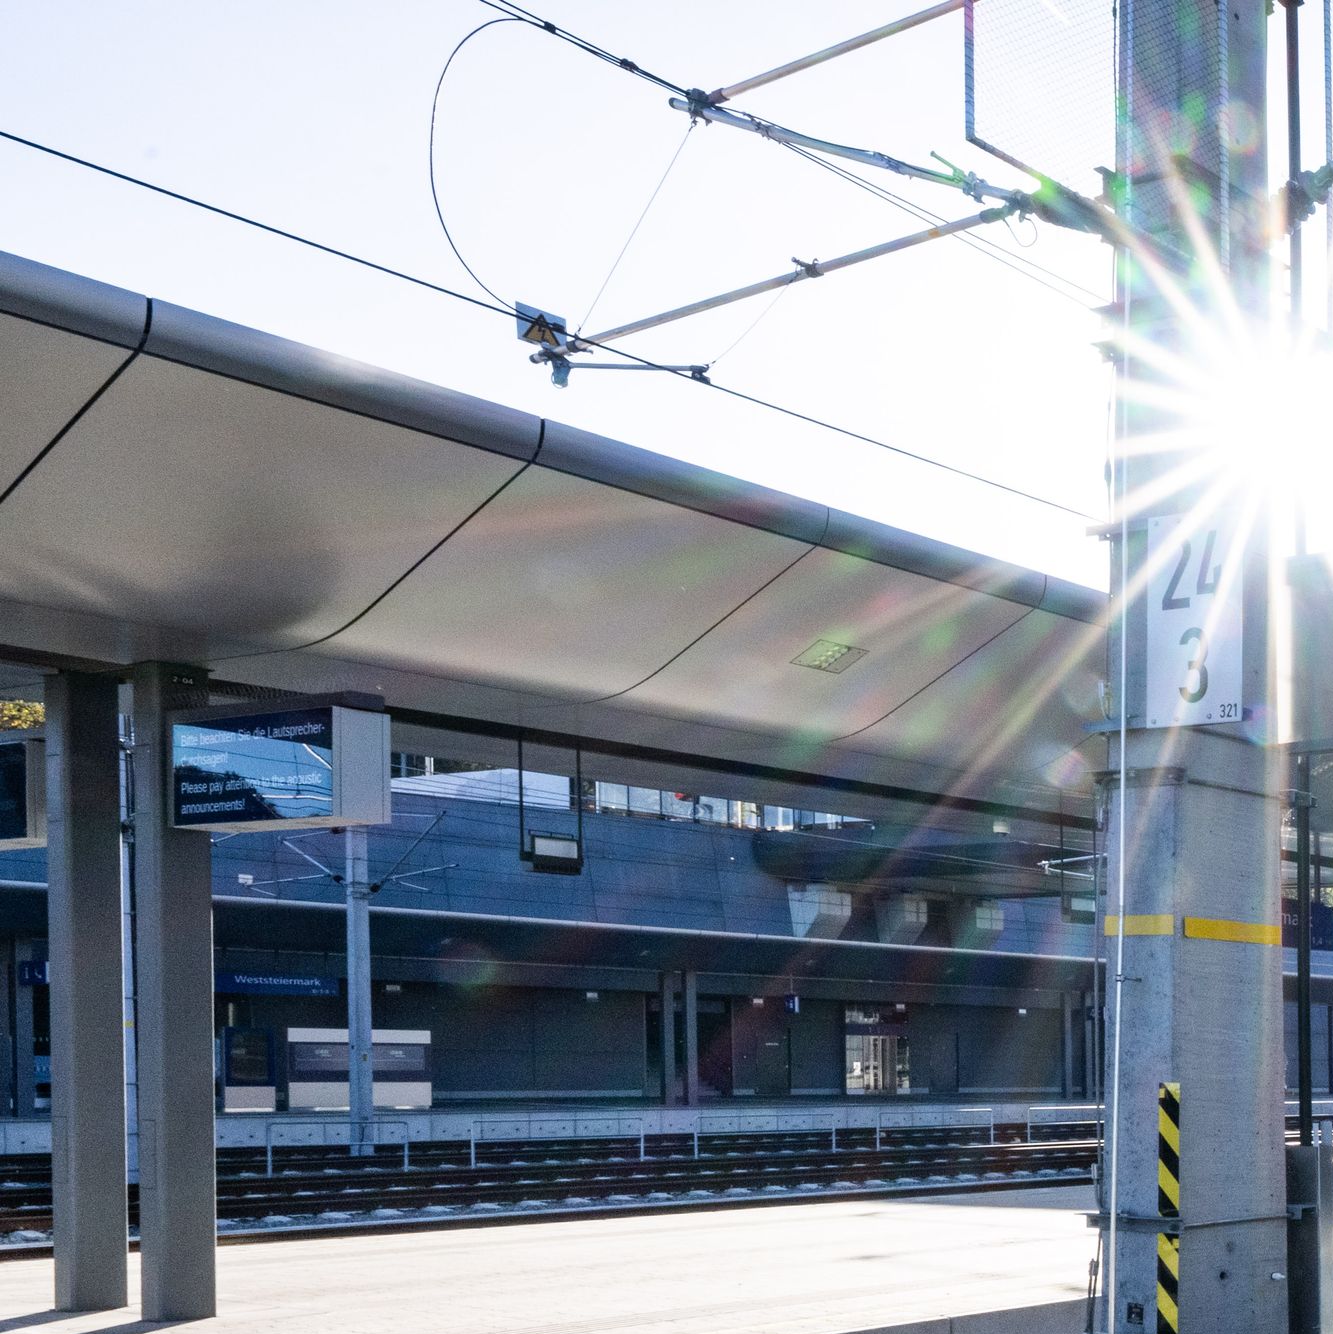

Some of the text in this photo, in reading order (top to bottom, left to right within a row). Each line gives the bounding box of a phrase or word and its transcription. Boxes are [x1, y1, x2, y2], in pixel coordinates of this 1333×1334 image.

[1178, 627, 1209, 704] 3
[1219, 703, 1239, 718] 321
[238, 728, 251, 741] Sie
[253, 726, 266, 739] die
[267, 722, 325, 740] Lautsprecher-
[181, 782, 208, 795] Please
[209, 780, 223, 794] pay
[181, 798, 246, 815] announcements!
[234, 975, 321, 986] Weststeiermark
